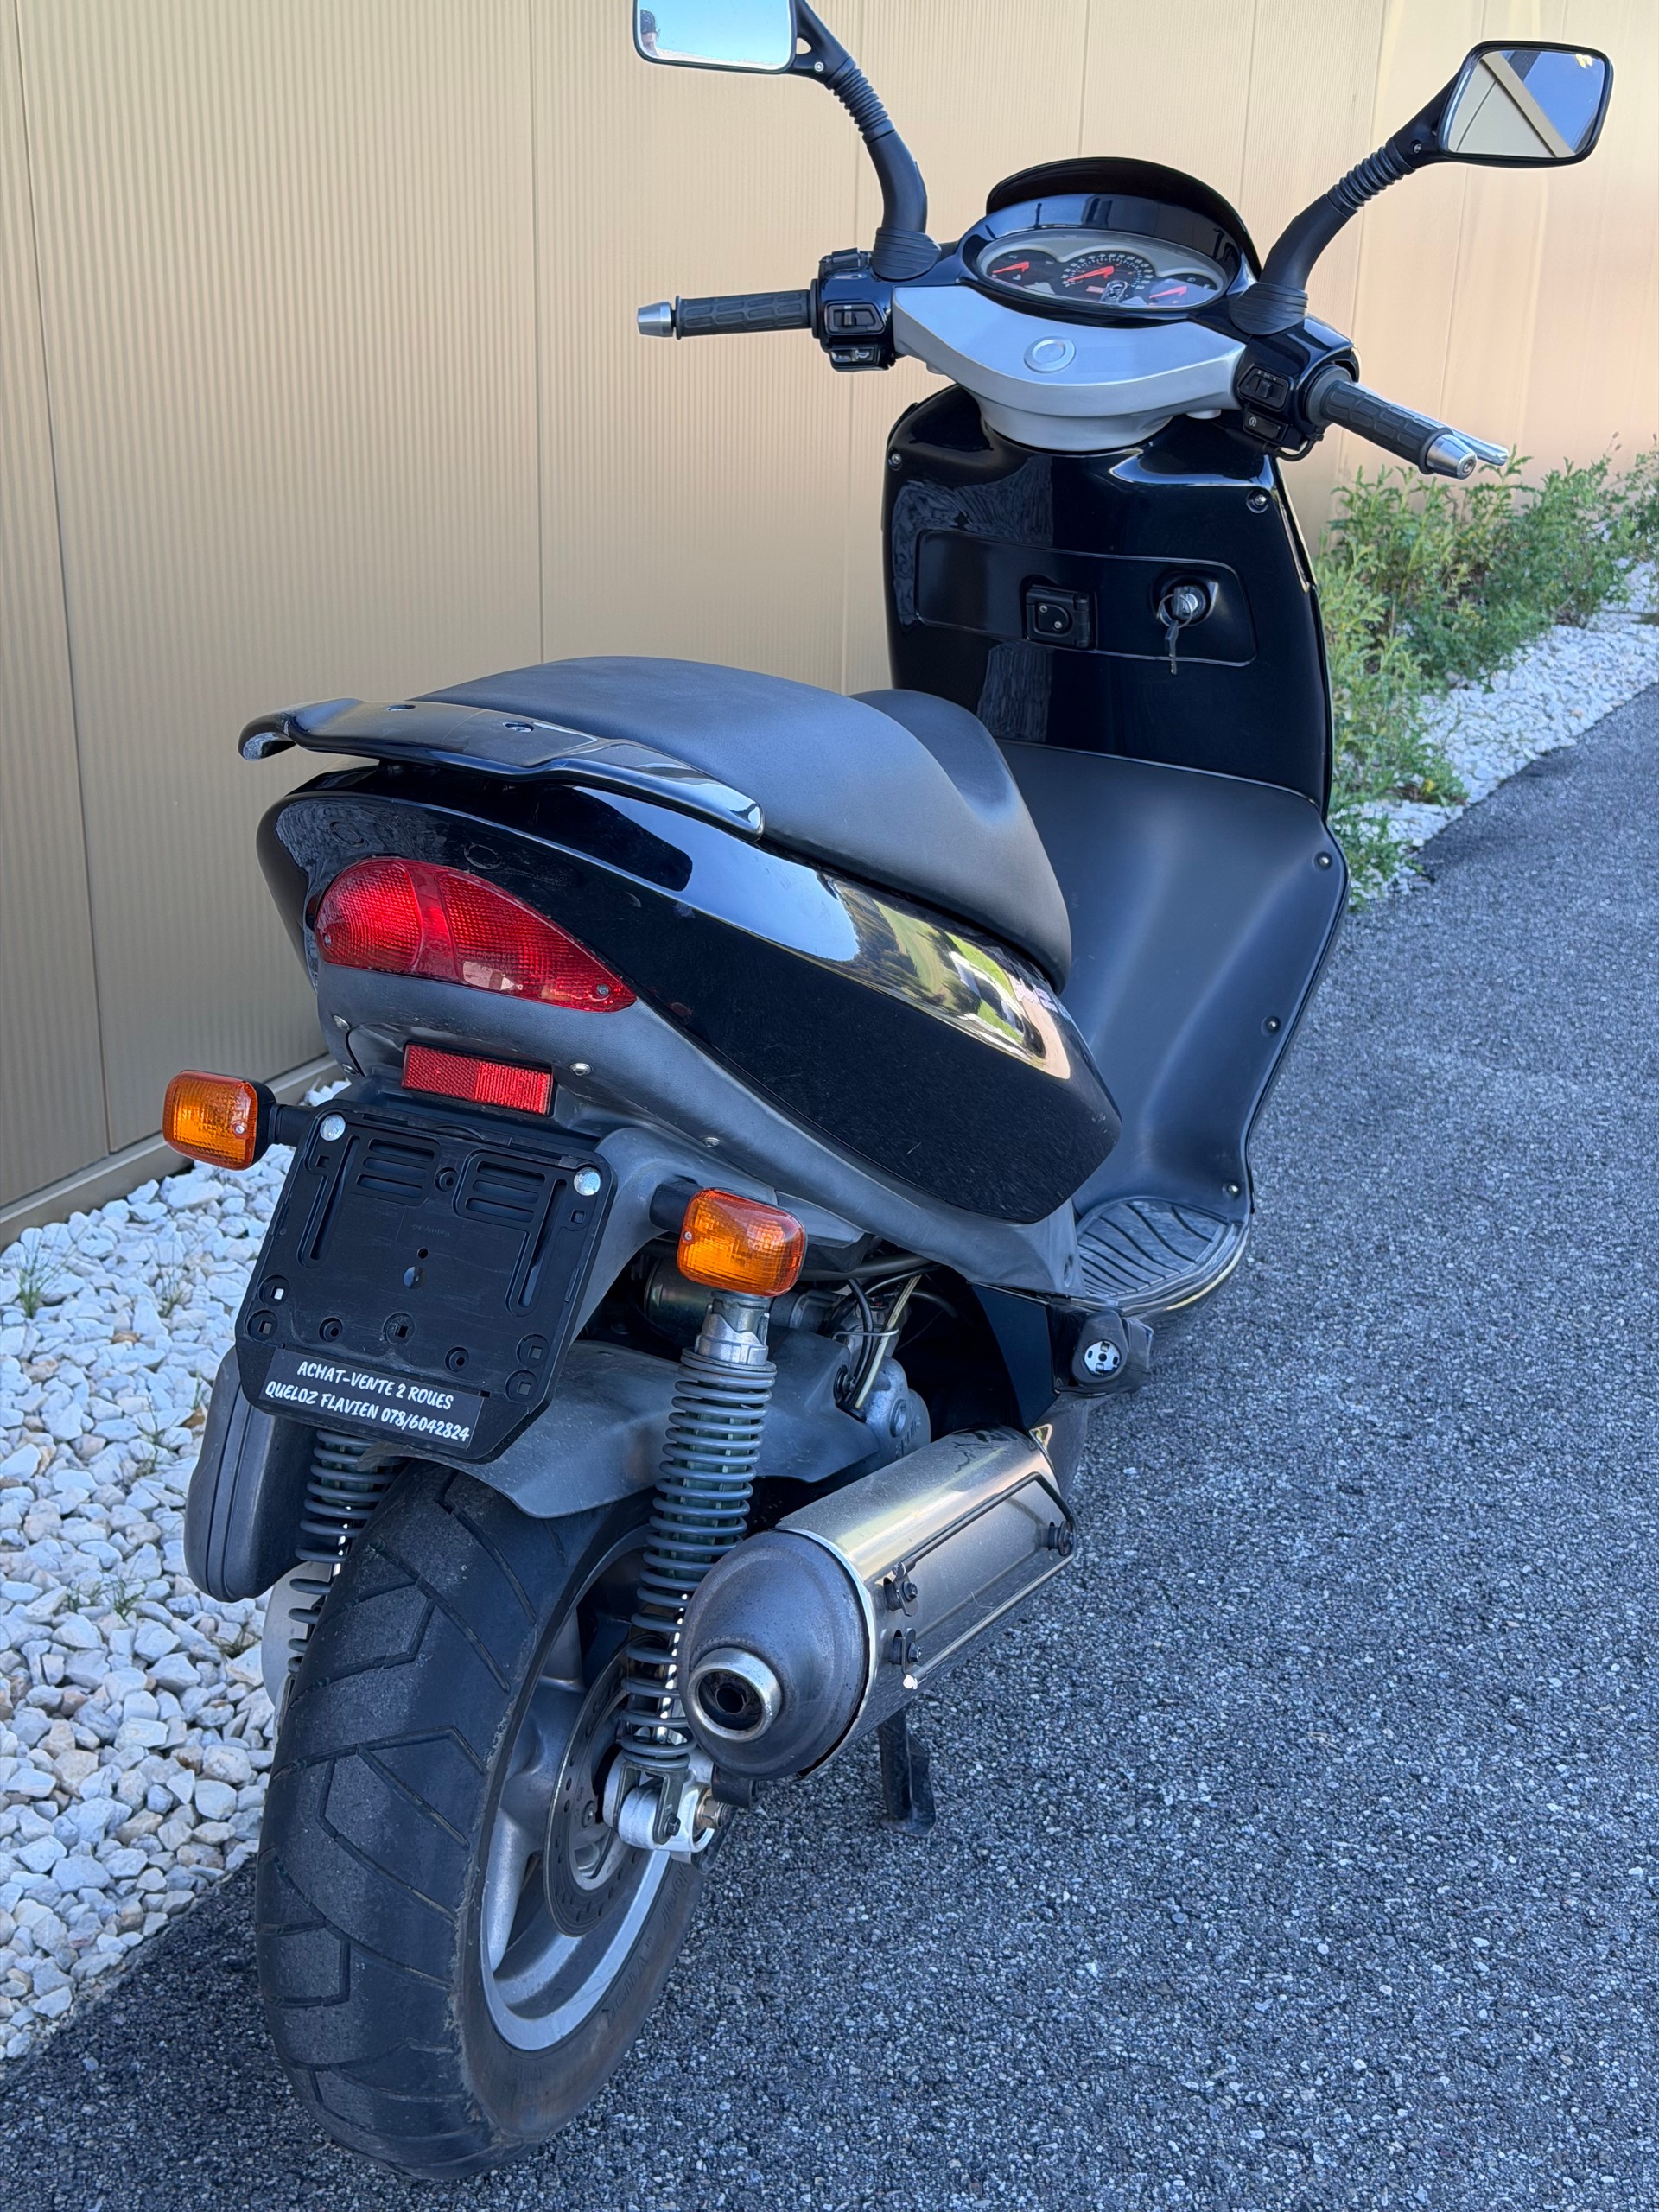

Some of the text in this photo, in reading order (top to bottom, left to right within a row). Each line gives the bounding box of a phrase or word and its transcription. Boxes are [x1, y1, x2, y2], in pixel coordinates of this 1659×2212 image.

[264, 1381, 471, 1442] QUELOZ FLAVIEN 078/6042824
[296, 1361, 454, 1410] ACHAT-VENTE 2 ROUES
